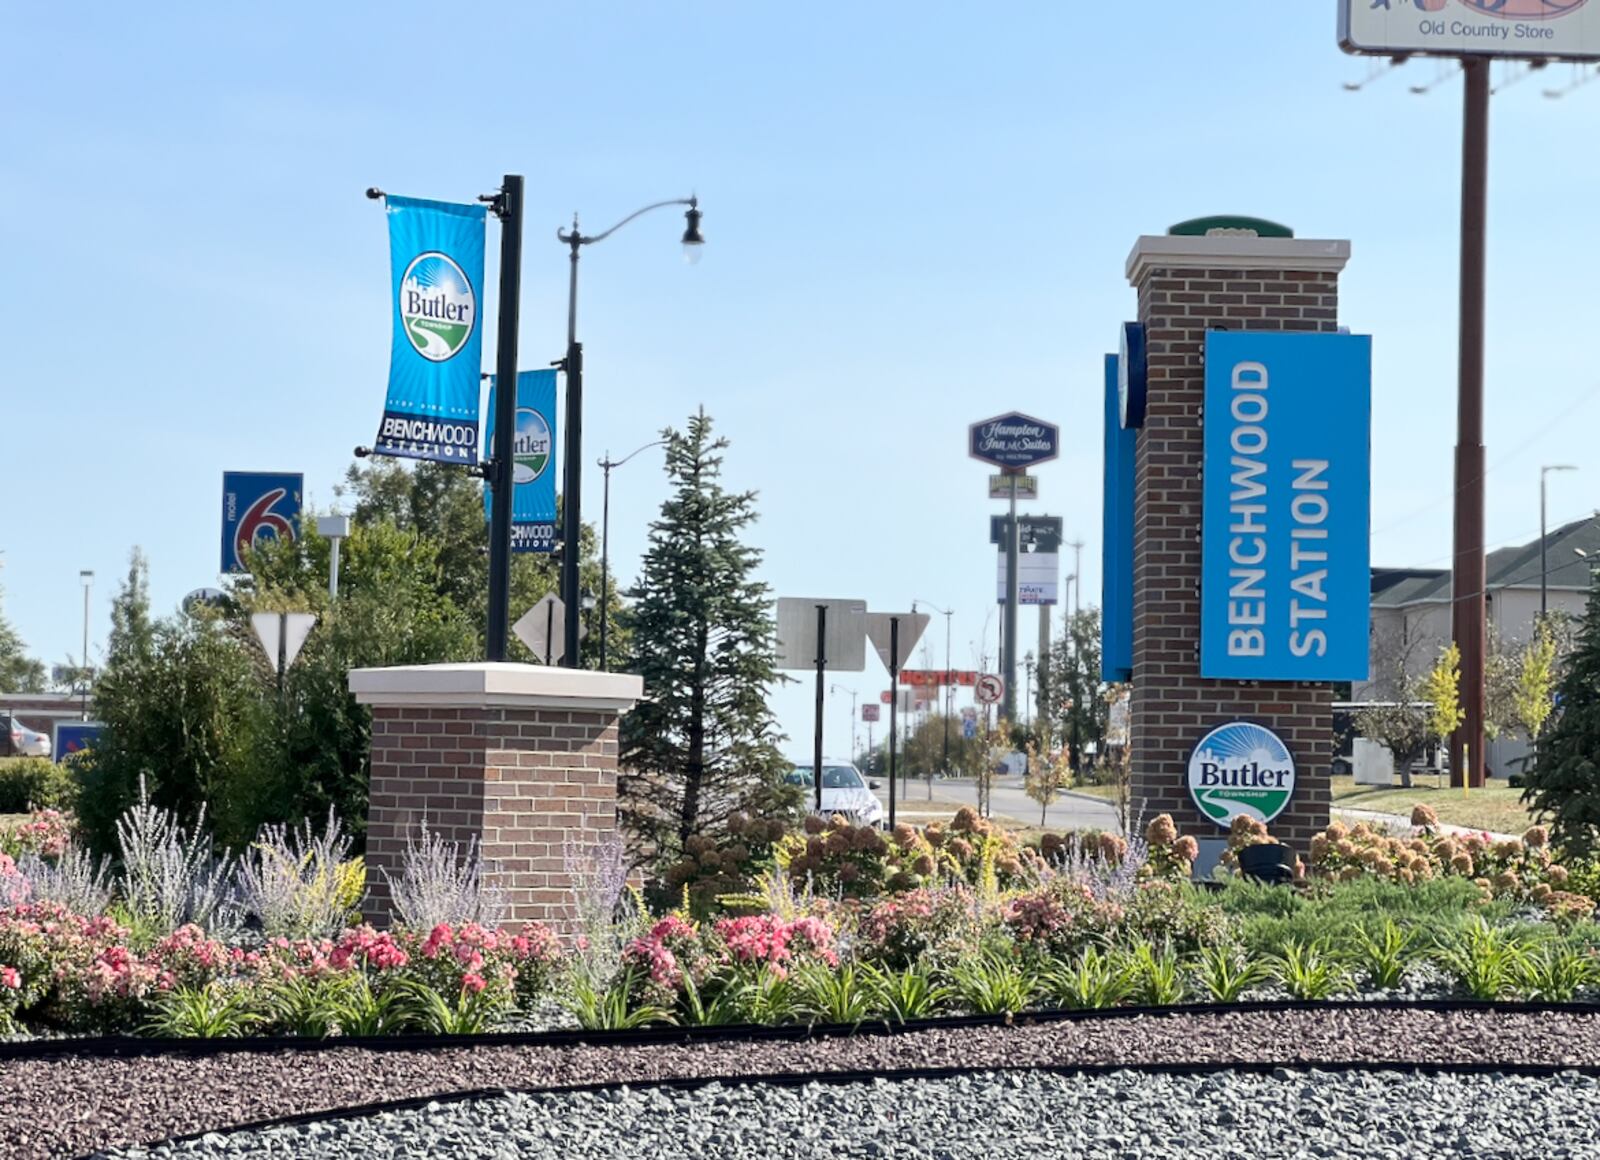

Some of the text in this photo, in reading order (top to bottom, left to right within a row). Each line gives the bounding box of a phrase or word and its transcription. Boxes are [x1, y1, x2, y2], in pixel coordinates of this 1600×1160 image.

[1419, 20, 1554, 39] Old Country Store
[407, 290, 469, 322] Butler
[382, 418, 475, 446] BENCHWOOD
[981, 422, 1046, 439] Hampton
[385, 439, 469, 458] STATION
[979, 438, 1008, 452] Inn
[1017, 437, 1052, 451] Suites
[227, 493, 236, 521] motel
[1227, 361, 1269, 657] BENCHWOOD
[510, 539, 549, 548] ATION
[1289, 459, 1330, 657] STATION
[1199, 762, 1290, 788] Butler
[1219, 791, 1268, 799] TOWNSHIP
